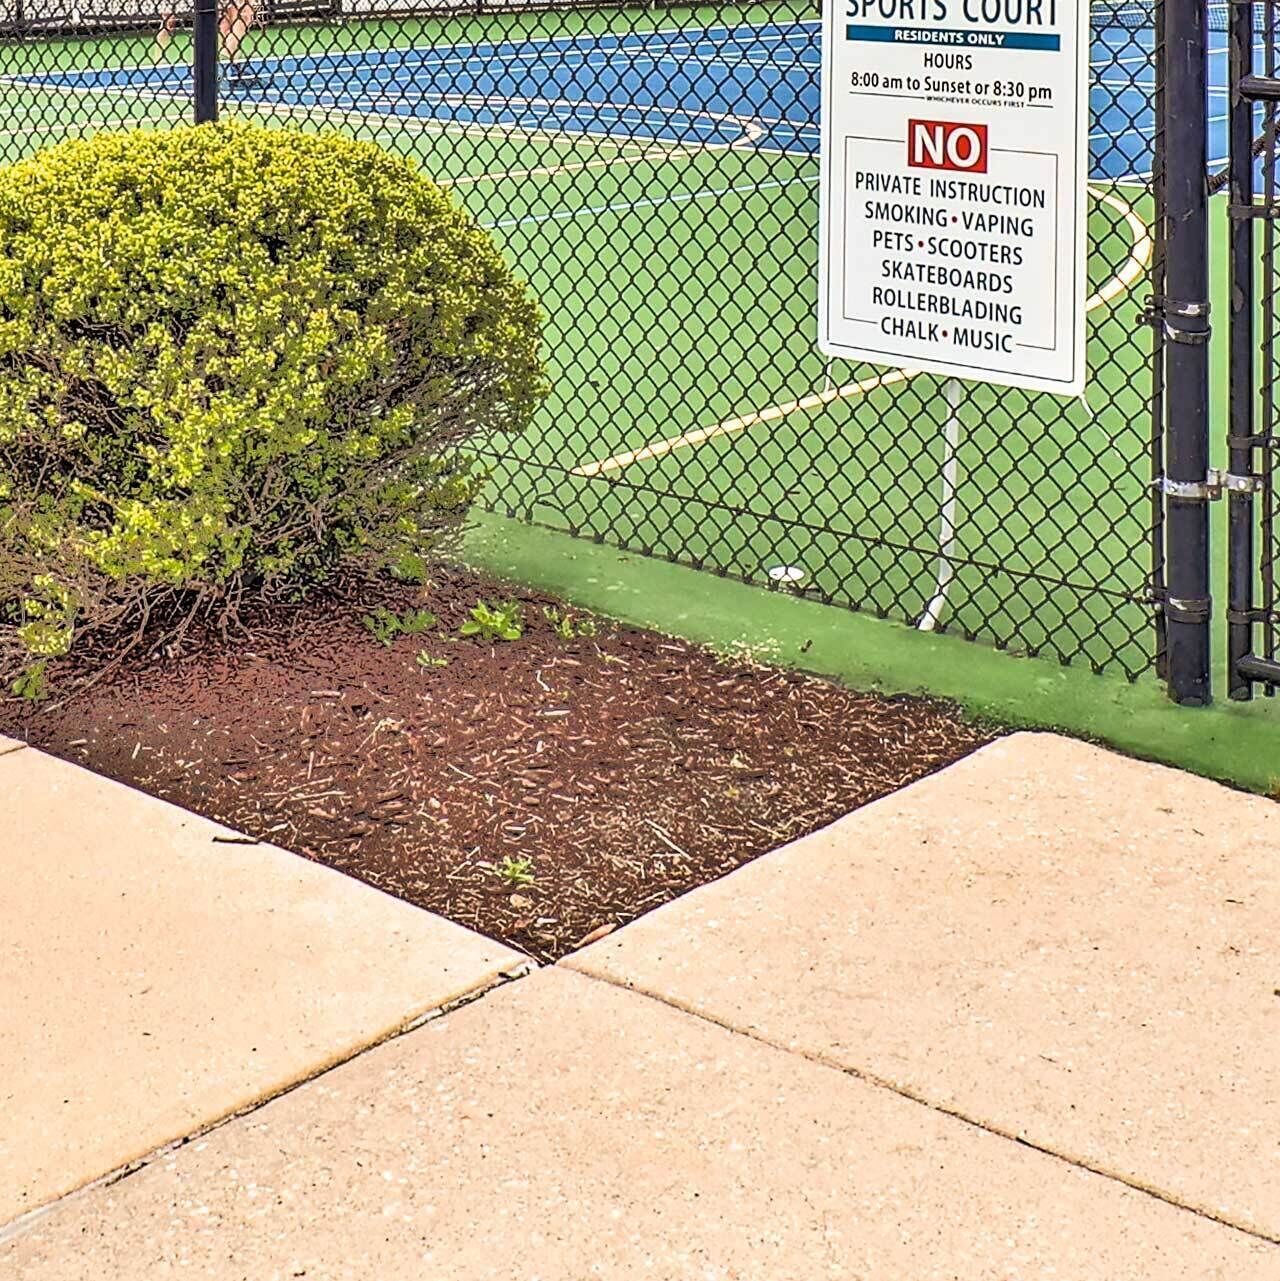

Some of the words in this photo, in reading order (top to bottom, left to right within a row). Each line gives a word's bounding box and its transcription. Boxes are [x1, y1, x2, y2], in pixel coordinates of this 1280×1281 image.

[894, 29, 964, 44] RESIDENTS
[967, 33, 1005, 46] ONLY
[924, 52, 972, 70] HOURS
[851, 72, 879, 88] 8:00
[882, 77, 903, 90] am
[906, 77, 920, 91] to
[924, 76, 971, 94] Sunset
[974, 82, 989, 94] or
[993, 80, 1024, 97] 8:30
[1028, 87, 1052, 102] pm
[926, 95, 970, 104] WHICHEVER
[972, 98, 1001, 106] OCCURS
[1003, 100, 1024, 108] FIRST
[914, 124, 980, 168] NO
[855, 172, 921, 196] PRIVATE
[930, 178, 1045, 208] INSTRUCTION
[864, 201, 948, 228] SMOKING
[962, 211, 1034, 237] VAPING
[873, 230, 914, 252] PETS
[928, 236, 1022, 265] SCOOTERS
[882, 260, 1013, 294] SKATEBOARDS
[872, 287, 1022, 324] ROLLERBLADING
[881, 316, 939, 342] CHALK
[953, 328, 1012, 353] MUSIC
